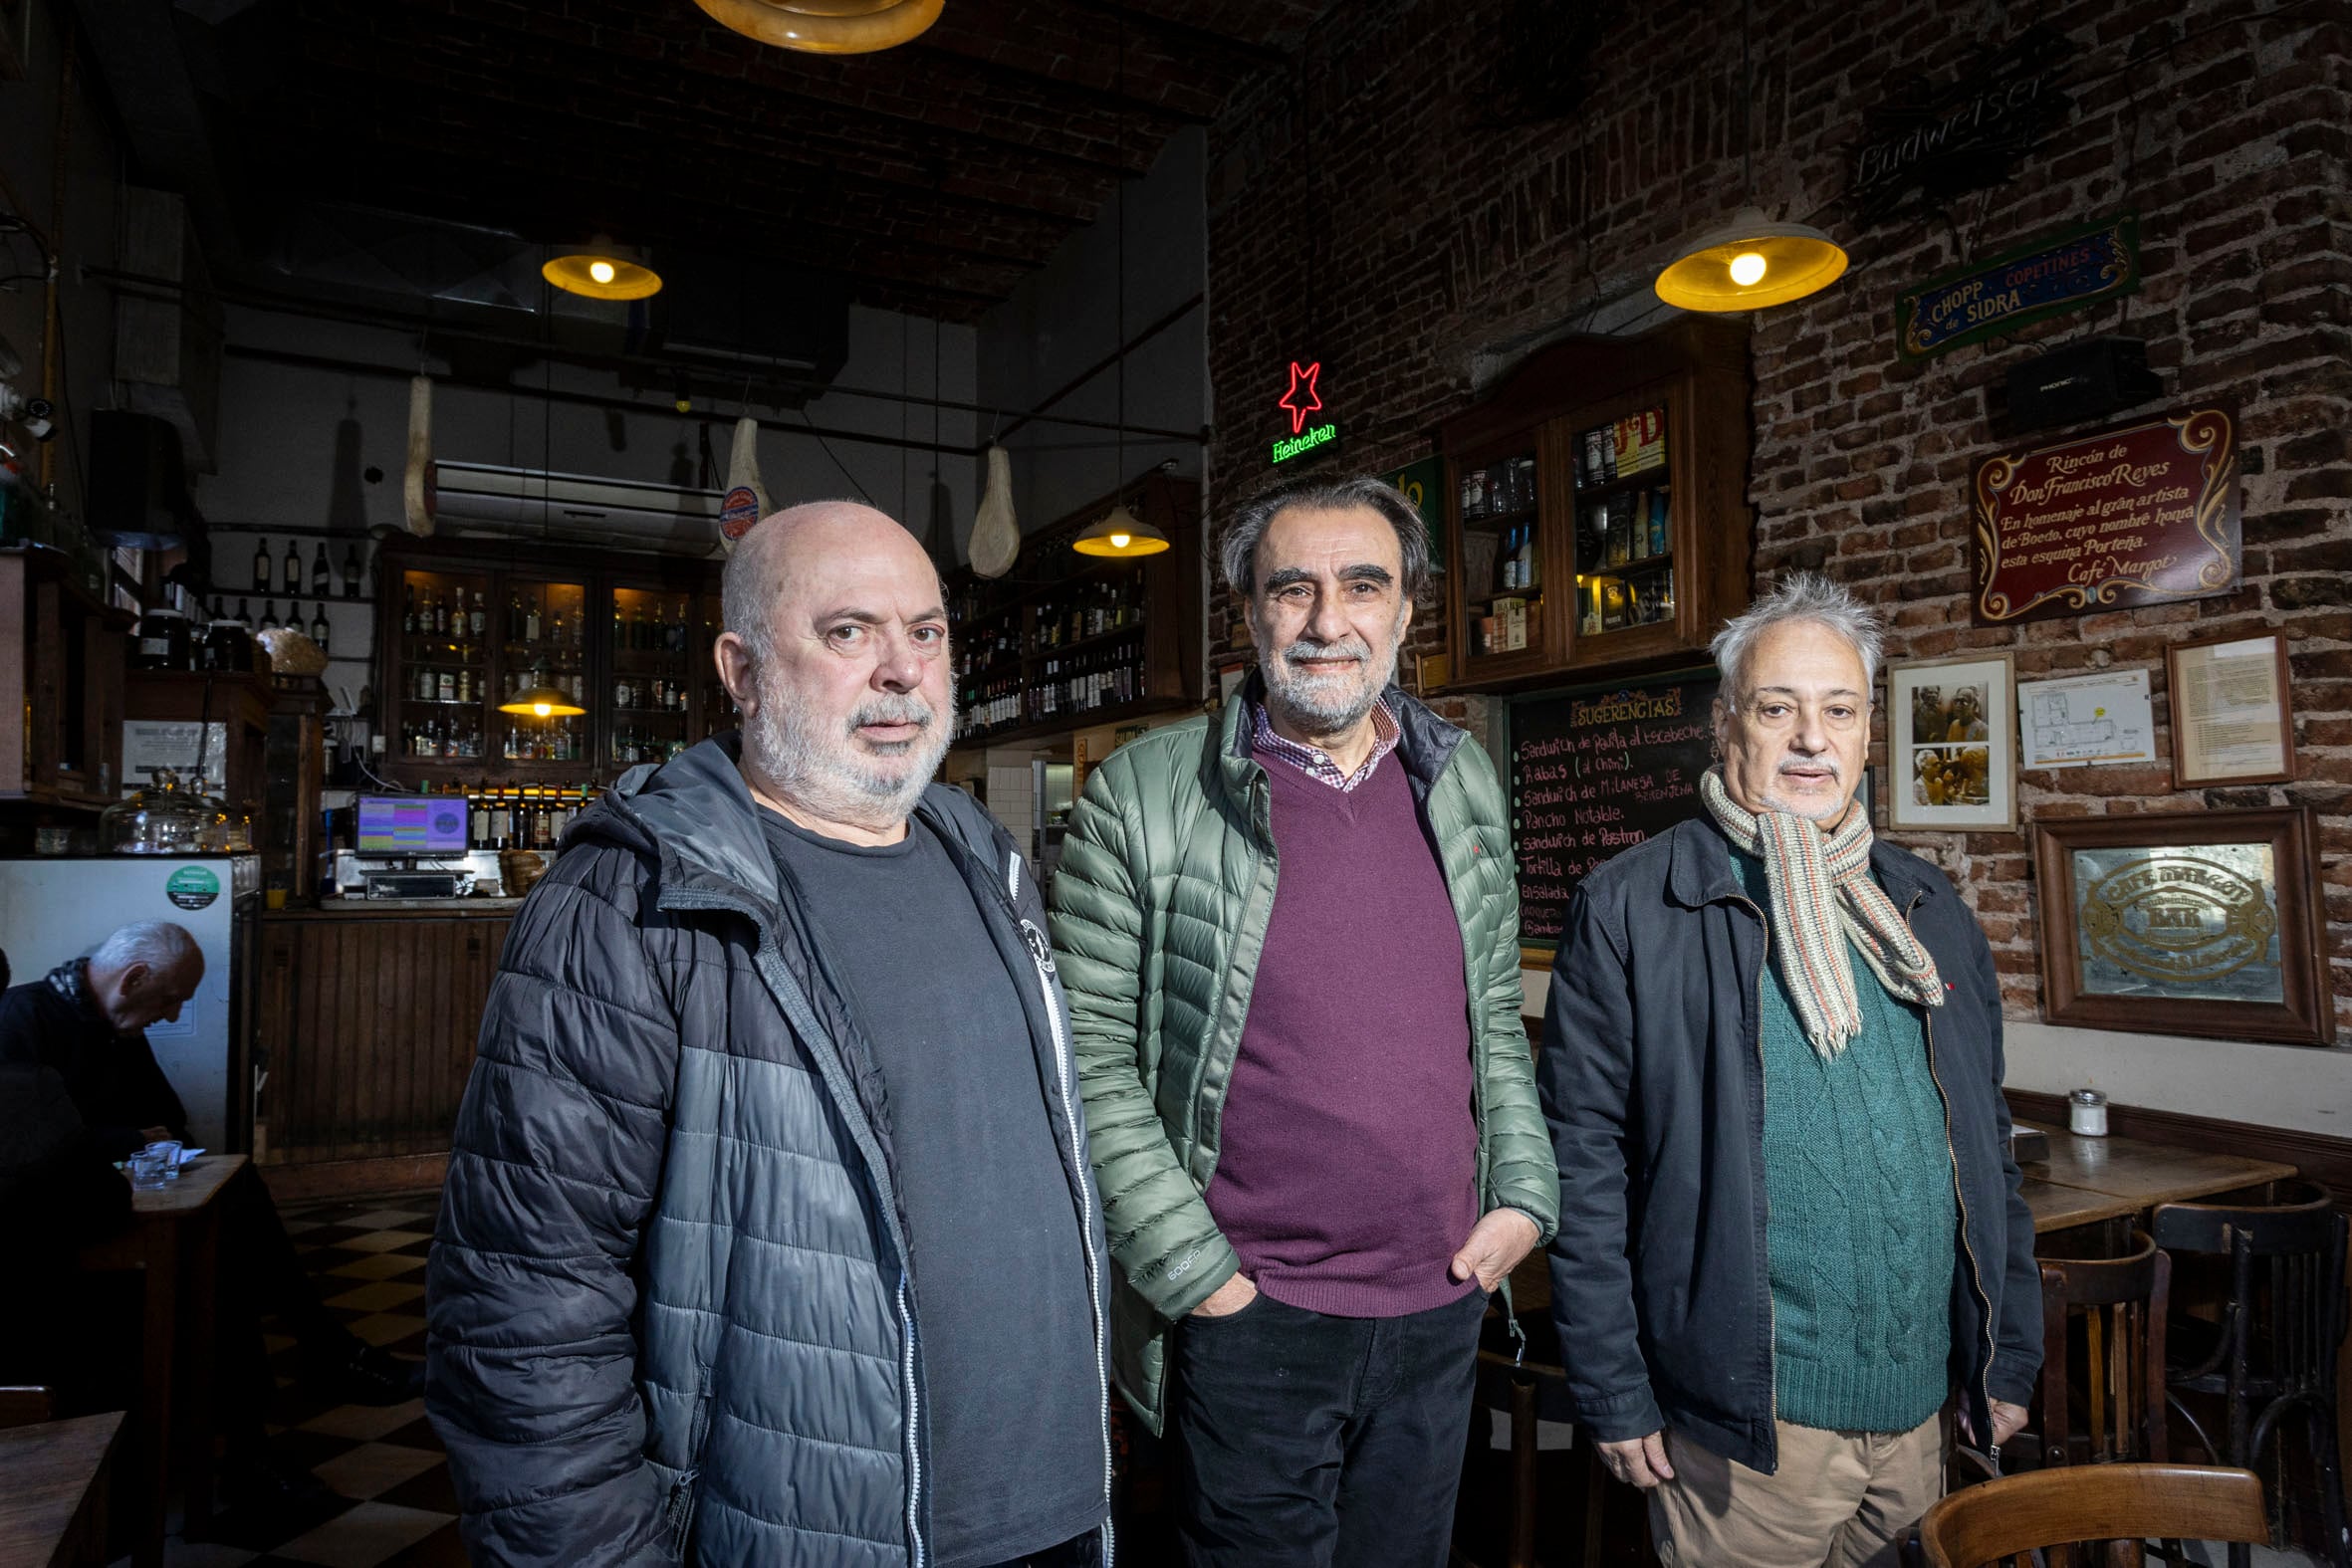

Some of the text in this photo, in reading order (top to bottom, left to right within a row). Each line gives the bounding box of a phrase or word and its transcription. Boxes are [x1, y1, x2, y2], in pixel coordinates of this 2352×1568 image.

[1931, 281, 1985, 323] CHOPP
[1966, 290, 2022, 323] SIDRA
[1273, 423, 1337, 464] Heineken
[2046, 444, 2128, 475] Rincón de
[2009, 461, 2171, 506] Don Francisco Reyes
[1999, 515, 2022, 533] En
[2023, 504, 2085, 529] homenaje
[2087, 499, 2101, 517] al
[2136, 486, 2190, 508] artista
[2001, 538, 2020, 551] de
[2065, 524, 2096, 544] cuyo
[2000, 556, 2027, 569] esta
[2031, 549, 2081, 566] esquina
[2067, 555, 2178, 587] Café Margot
[1577, 699, 1675, 728] SUGERENCIAS
[1521, 738, 1576, 761] Sandwich
[1577, 734, 1591, 750] de
[1629, 724, 1641, 747] al
[1523, 785, 1578, 808] Sandwich
[1581, 784, 1597, 799] de
[1665, 768, 1683, 784] DE
[1523, 809, 1566, 829] Pancho
[1581, 830, 1596, 845] de
[1567, 859, 1583, 875] de
